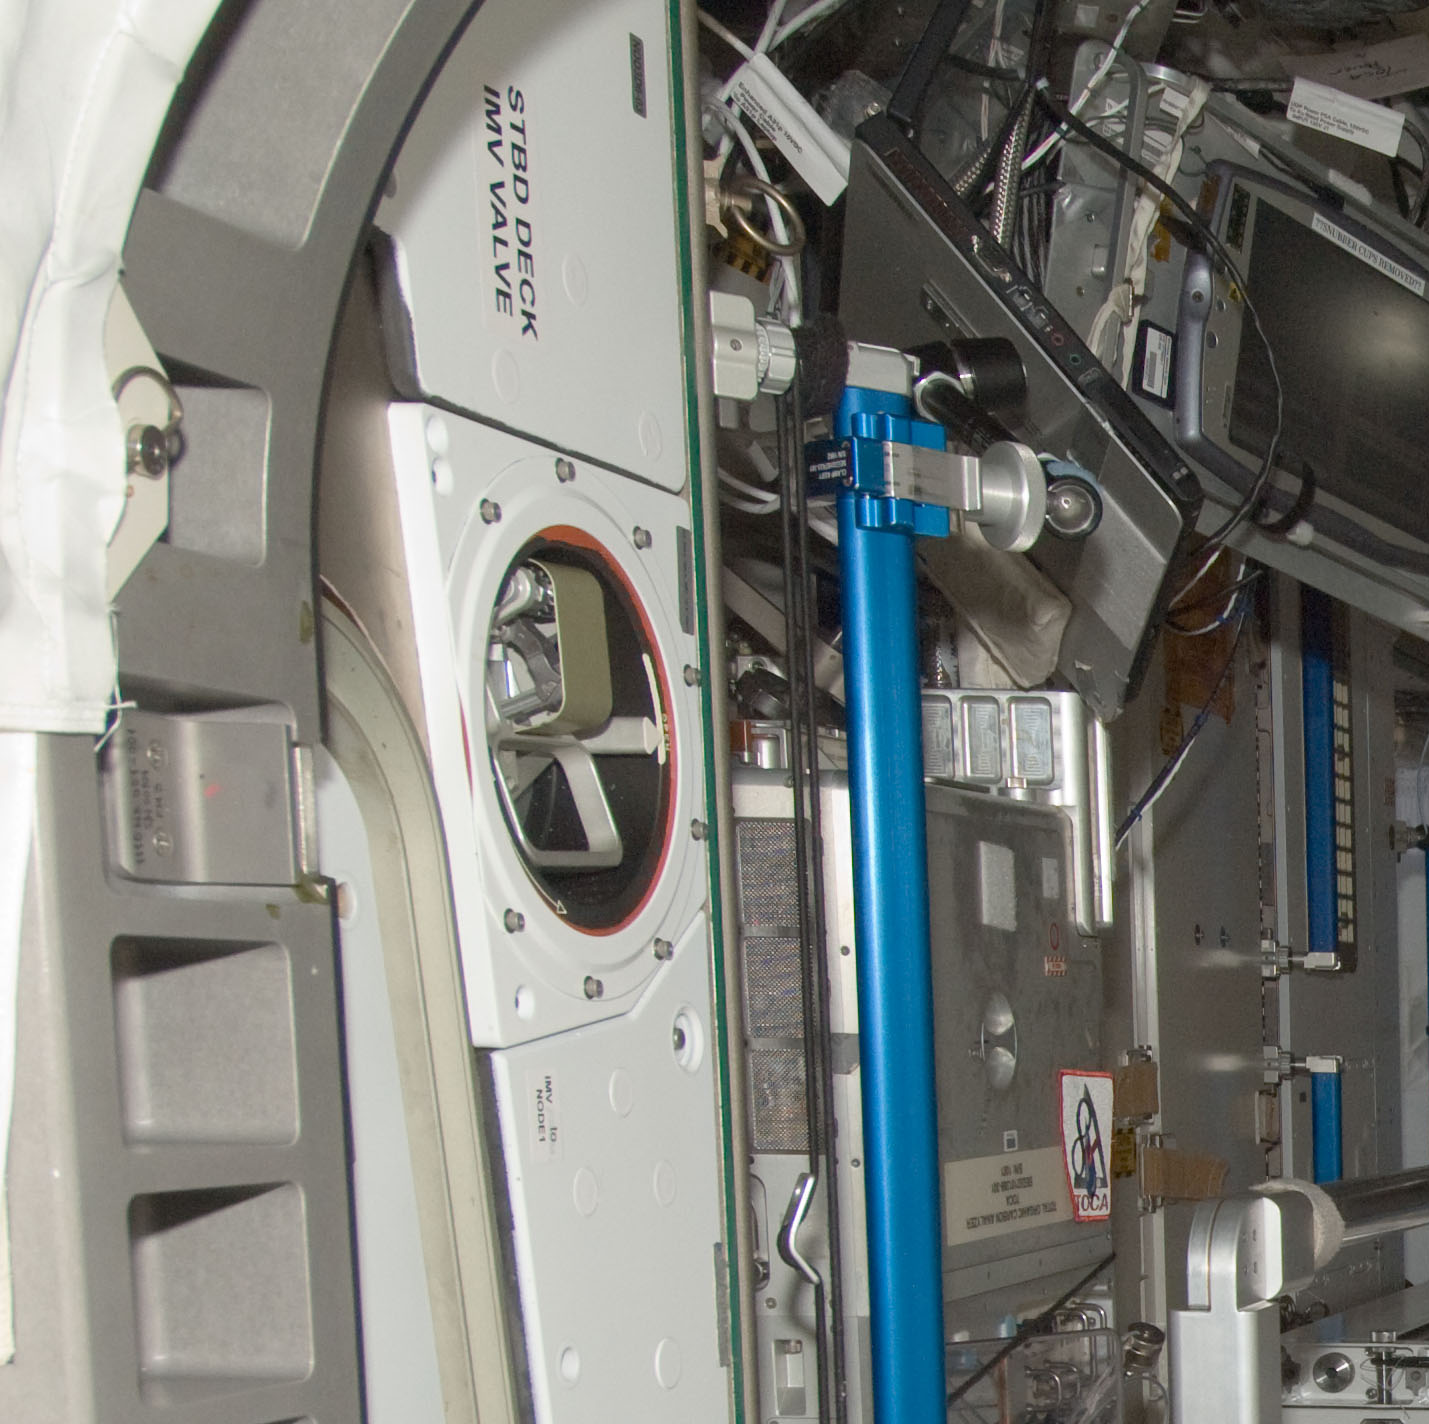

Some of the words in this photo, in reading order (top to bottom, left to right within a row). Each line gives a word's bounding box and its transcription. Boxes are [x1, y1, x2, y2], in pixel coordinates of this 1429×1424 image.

[483, 84, 505, 168] IMV
[508, 85, 529, 205] STBD
[490, 181, 513, 317] VALVE
[1358, 243, 1379, 264] CUPS
[515, 217, 538, 341] DECK
[544, 1075, 553, 1104] IMV
[536, 1089, 547, 1142] NODE1
[996, 1209, 1019, 1224] CARBON
[1018, 1204, 1041, 1220] ORGANIC
[1074, 1193, 1109, 1212] TOCA
[966, 1213, 996, 1230] ANALYZER
